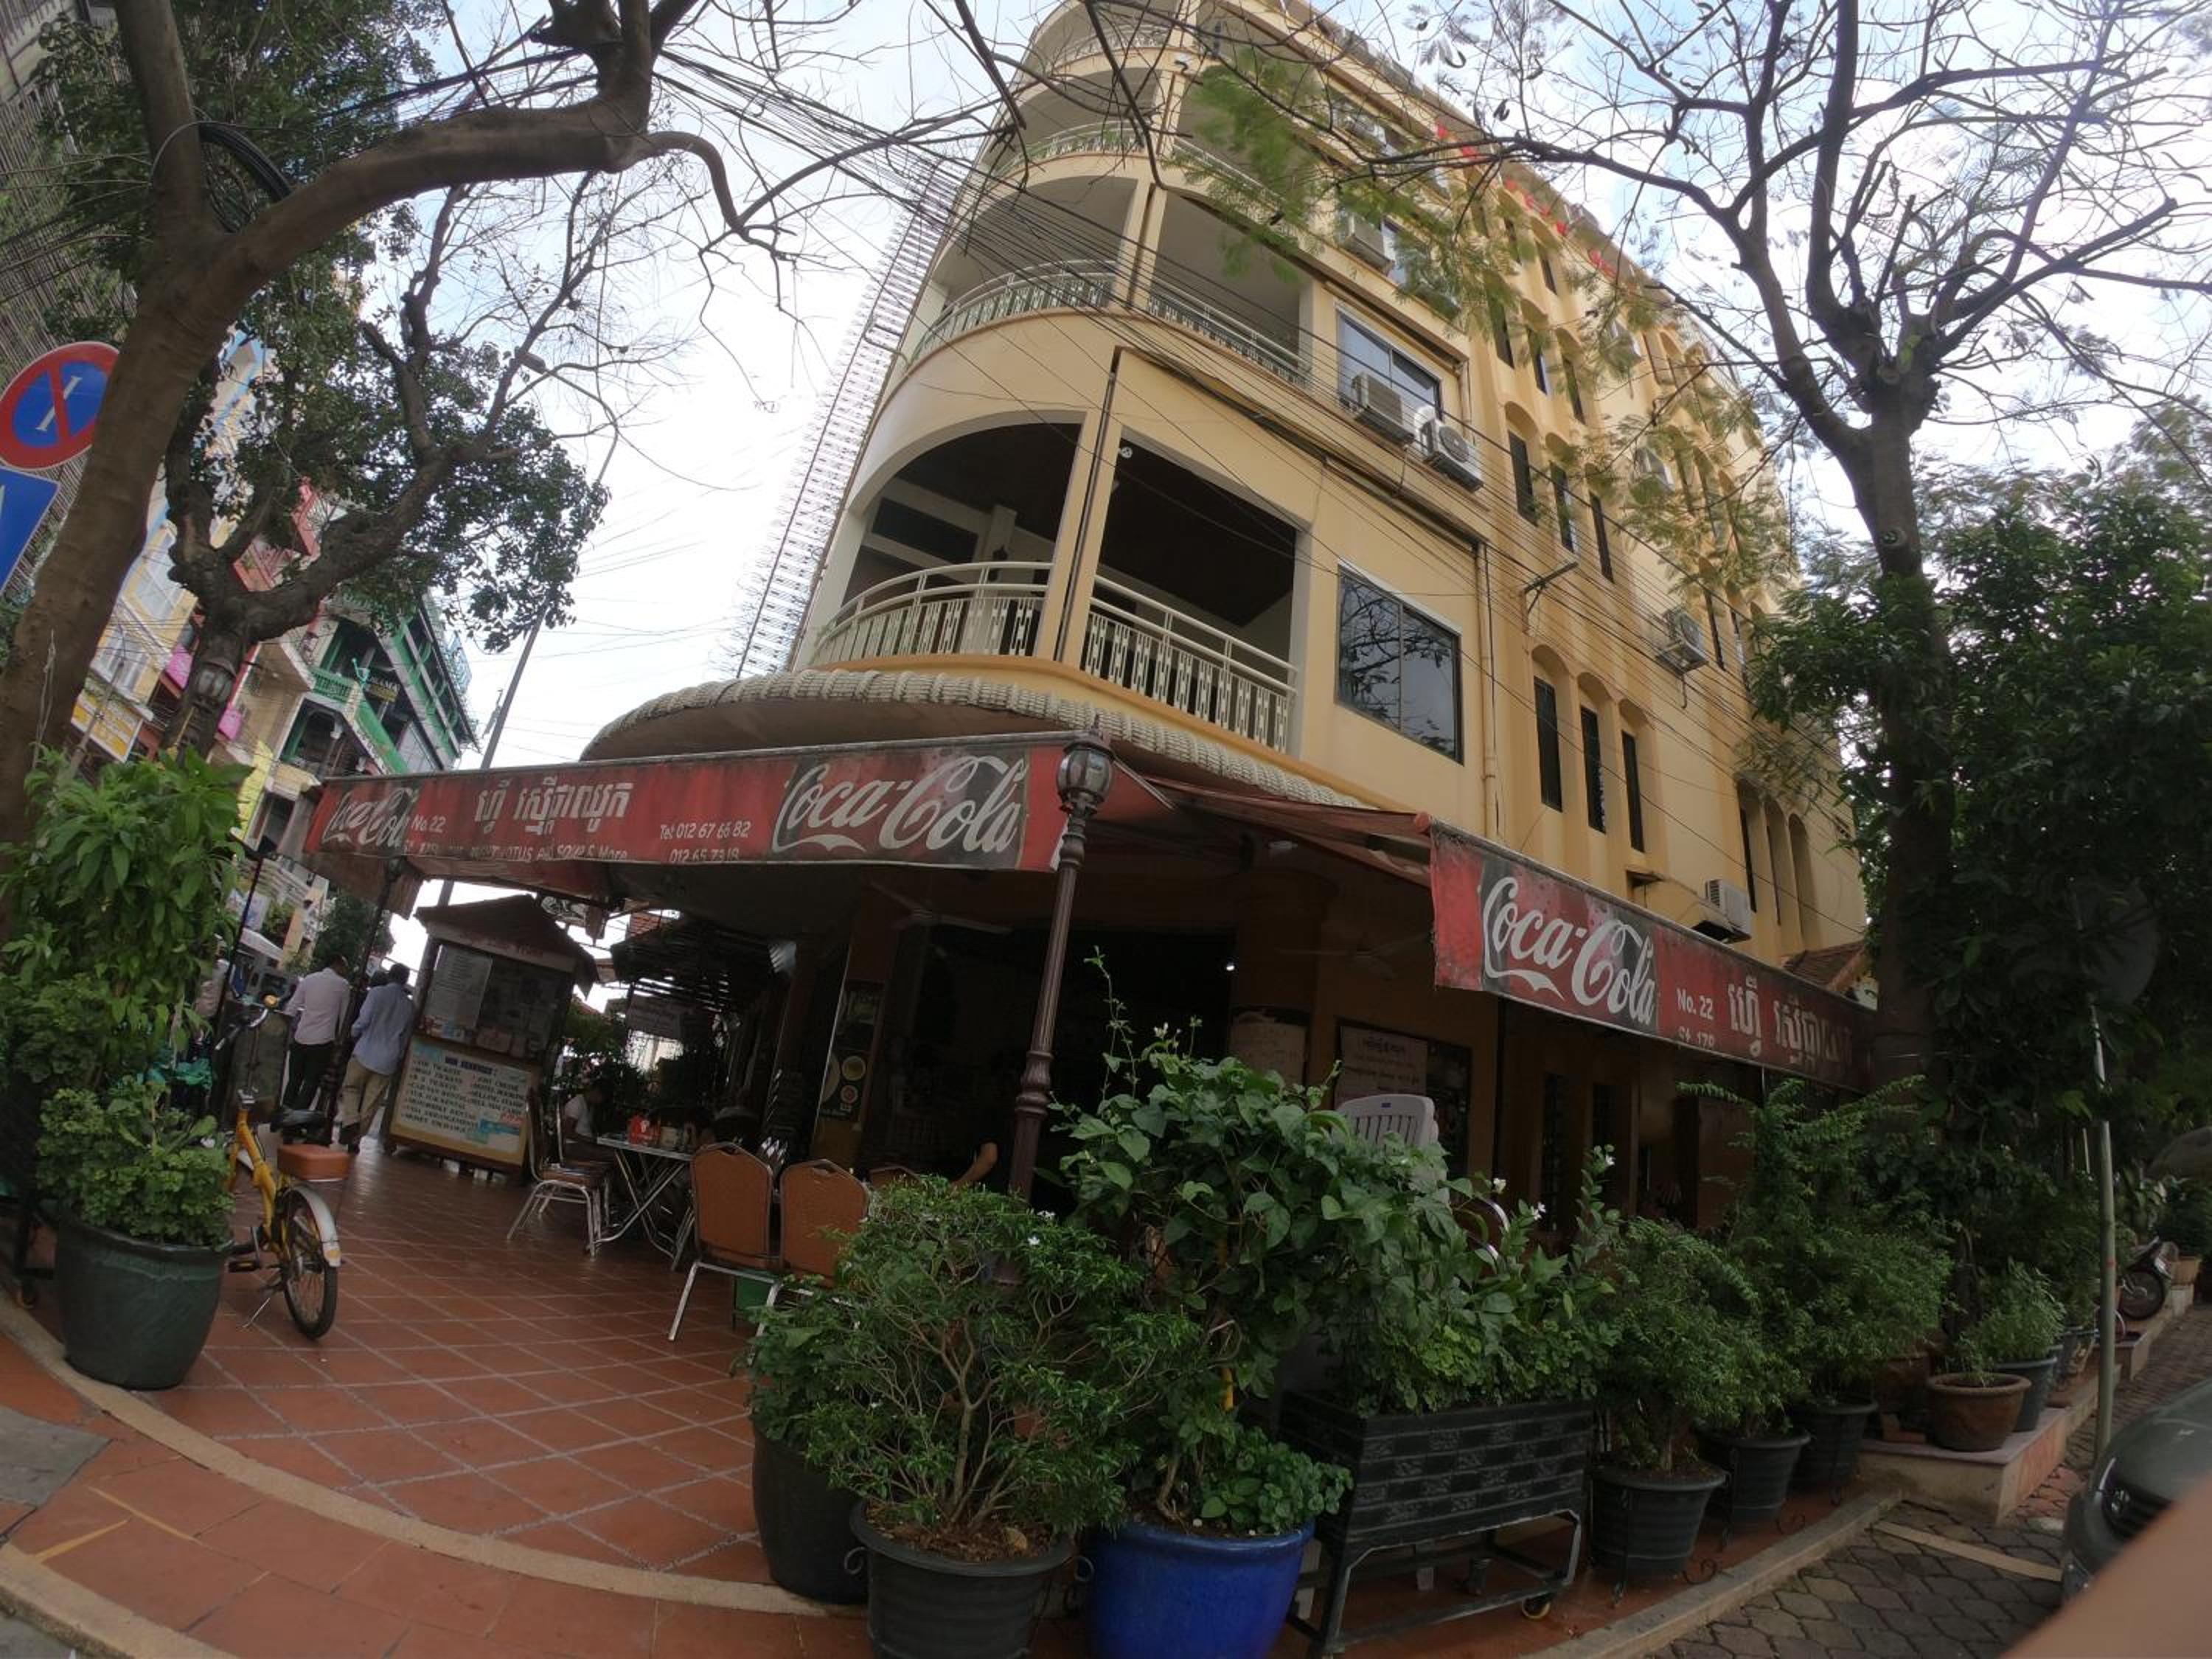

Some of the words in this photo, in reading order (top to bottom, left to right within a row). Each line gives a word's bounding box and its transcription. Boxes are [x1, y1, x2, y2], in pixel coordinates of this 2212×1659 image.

[321, 787, 420, 848] Coca-Cola
[429, 815, 447, 833] 22
[771, 755, 1028, 854] Coca-Cola
[676, 822, 697, 839] 012
[698, 822, 717, 839] 67
[733, 820, 751, 839] 82
[1482, 876, 1657, 1026] Coca-Cola
[1676, 987, 1697, 1015] No.
[1699, 995, 1715, 1020] 22
